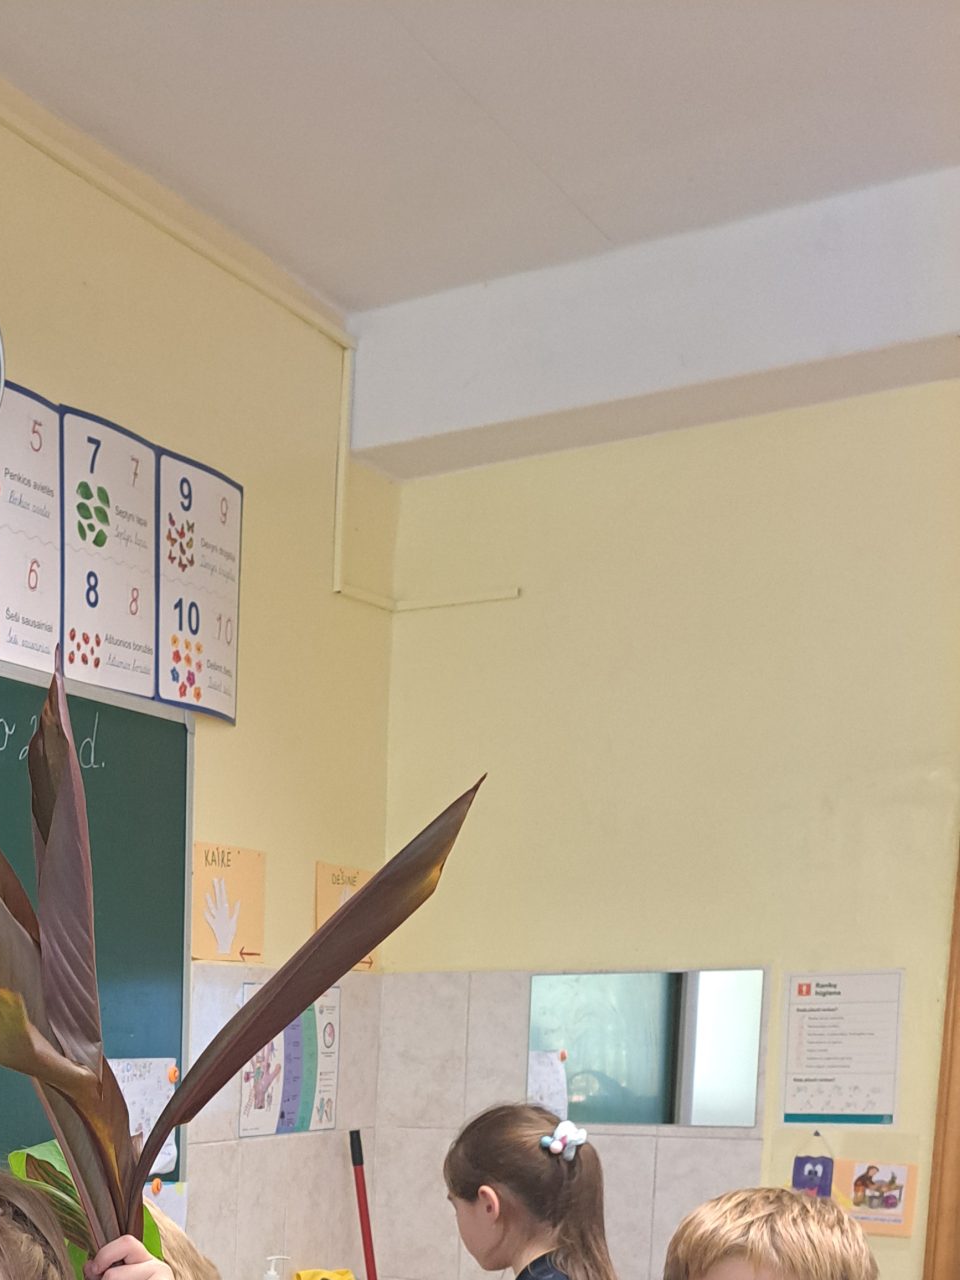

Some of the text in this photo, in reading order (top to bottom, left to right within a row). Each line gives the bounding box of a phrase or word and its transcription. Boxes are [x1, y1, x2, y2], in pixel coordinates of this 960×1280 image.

[29, 419, 43, 452] 5
[86, 436, 101, 474] 7
[129, 455, 140, 488] 7
[179, 477, 192, 512] 9
[219, 497, 229, 526] 9
[27, 559, 40, 592] 6
[86, 570, 99, 608] 8
[129, 587, 139, 616] 8
[173, 597, 200, 636] 10
[216, 613, 234, 646] 10
[79, 712, 106, 768] d.
